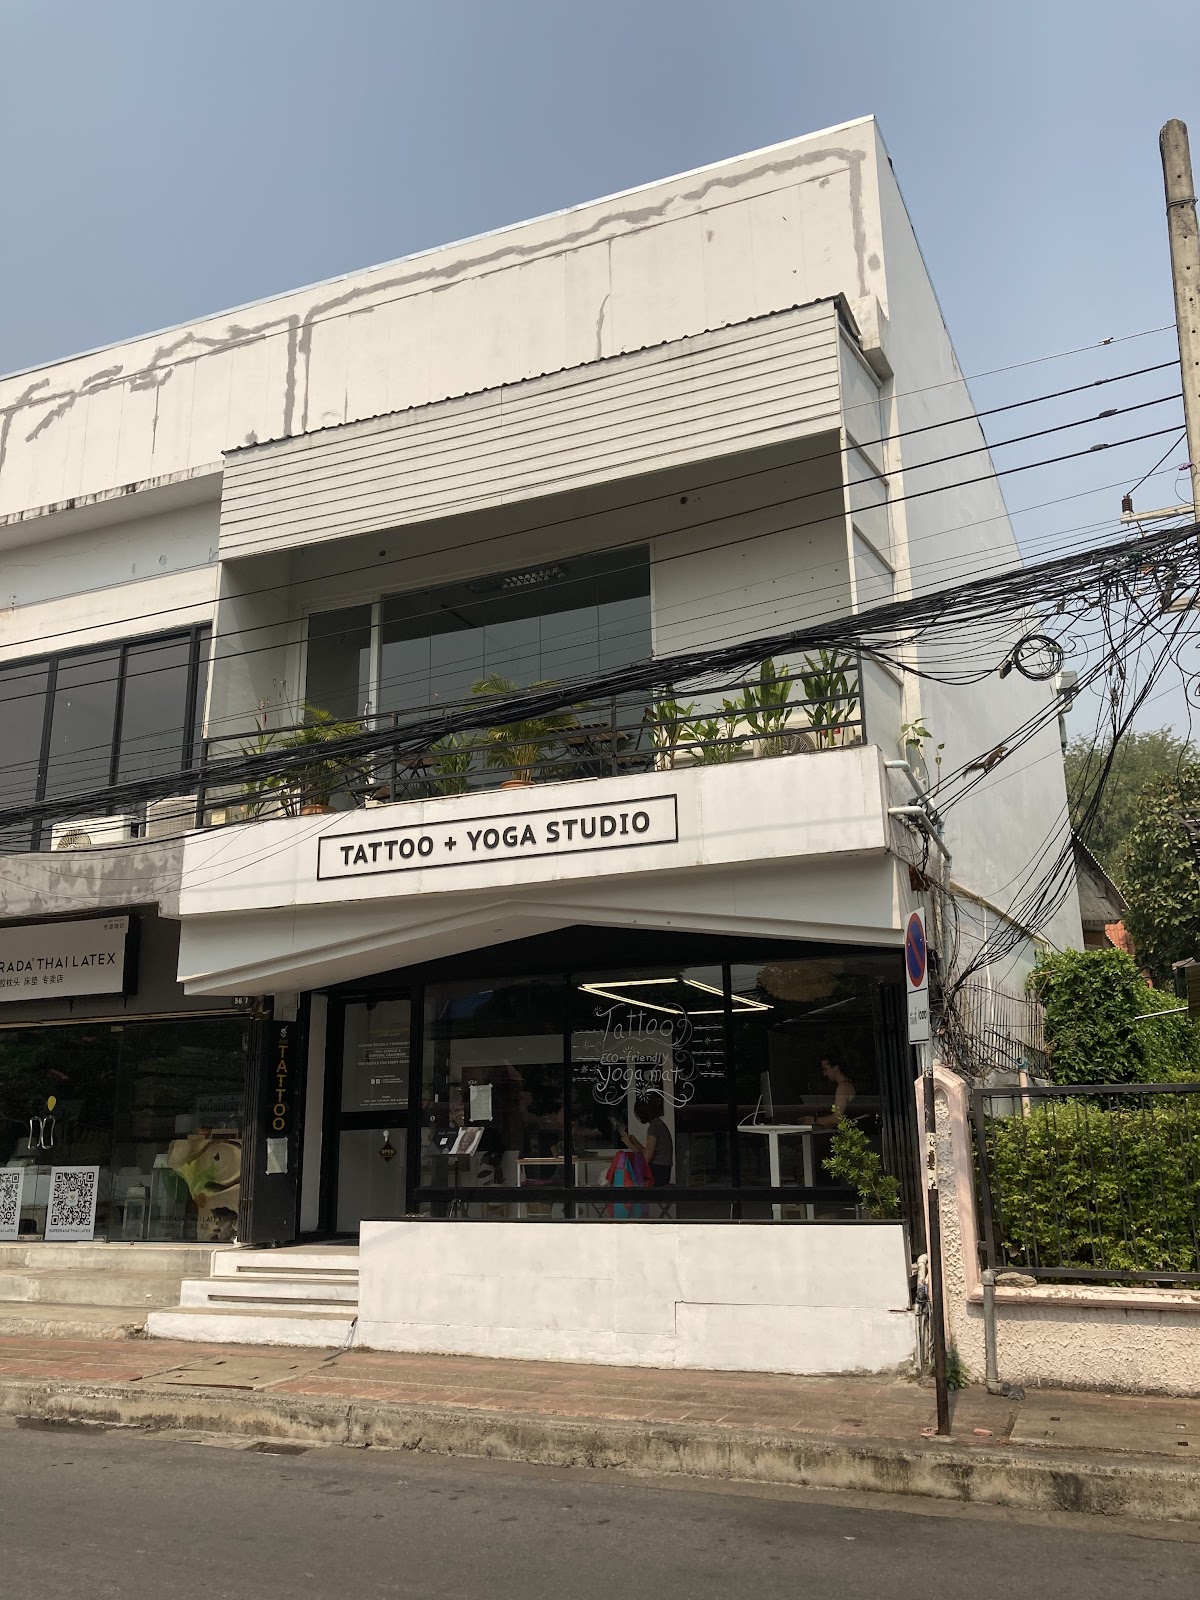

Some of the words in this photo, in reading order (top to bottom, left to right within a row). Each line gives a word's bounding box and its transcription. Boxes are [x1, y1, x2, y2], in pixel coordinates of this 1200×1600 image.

[340, 835, 434, 866] TATTOO
[444, 836, 457, 852] +
[466, 823, 537, 851] YOGA
[546, 810, 651, 843] STUDIO
[37, 955, 68, 970] THAI
[72, 952, 116, 968] LATEX
[596, 1002, 675, 1043] Tattoo
[272, 1045, 289, 1131] TATTOO
[651, 1066, 685, 1084] mat
